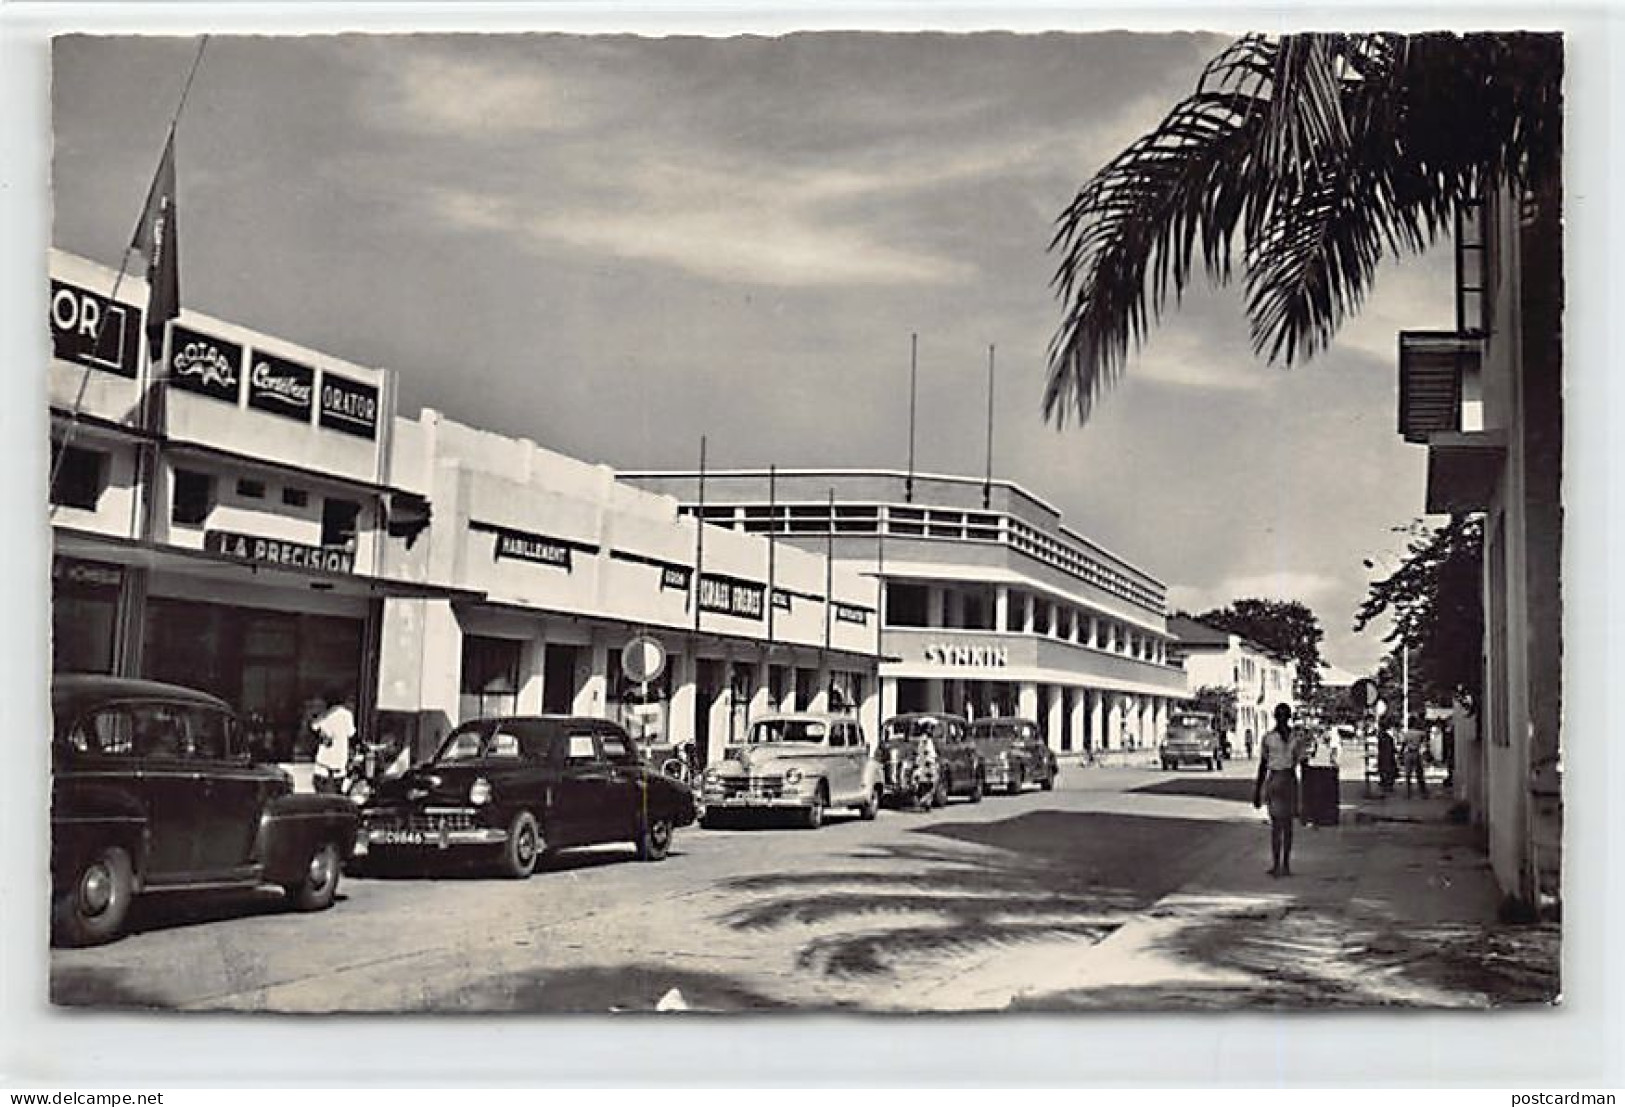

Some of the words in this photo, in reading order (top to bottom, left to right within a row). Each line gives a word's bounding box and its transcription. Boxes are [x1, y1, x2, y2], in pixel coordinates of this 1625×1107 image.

[323, 385, 376, 420] ORATOR
[220, 533, 247, 557] LA
[255, 538, 351, 574] PRECISION
[924, 643, 1008, 669] SYNKIN
